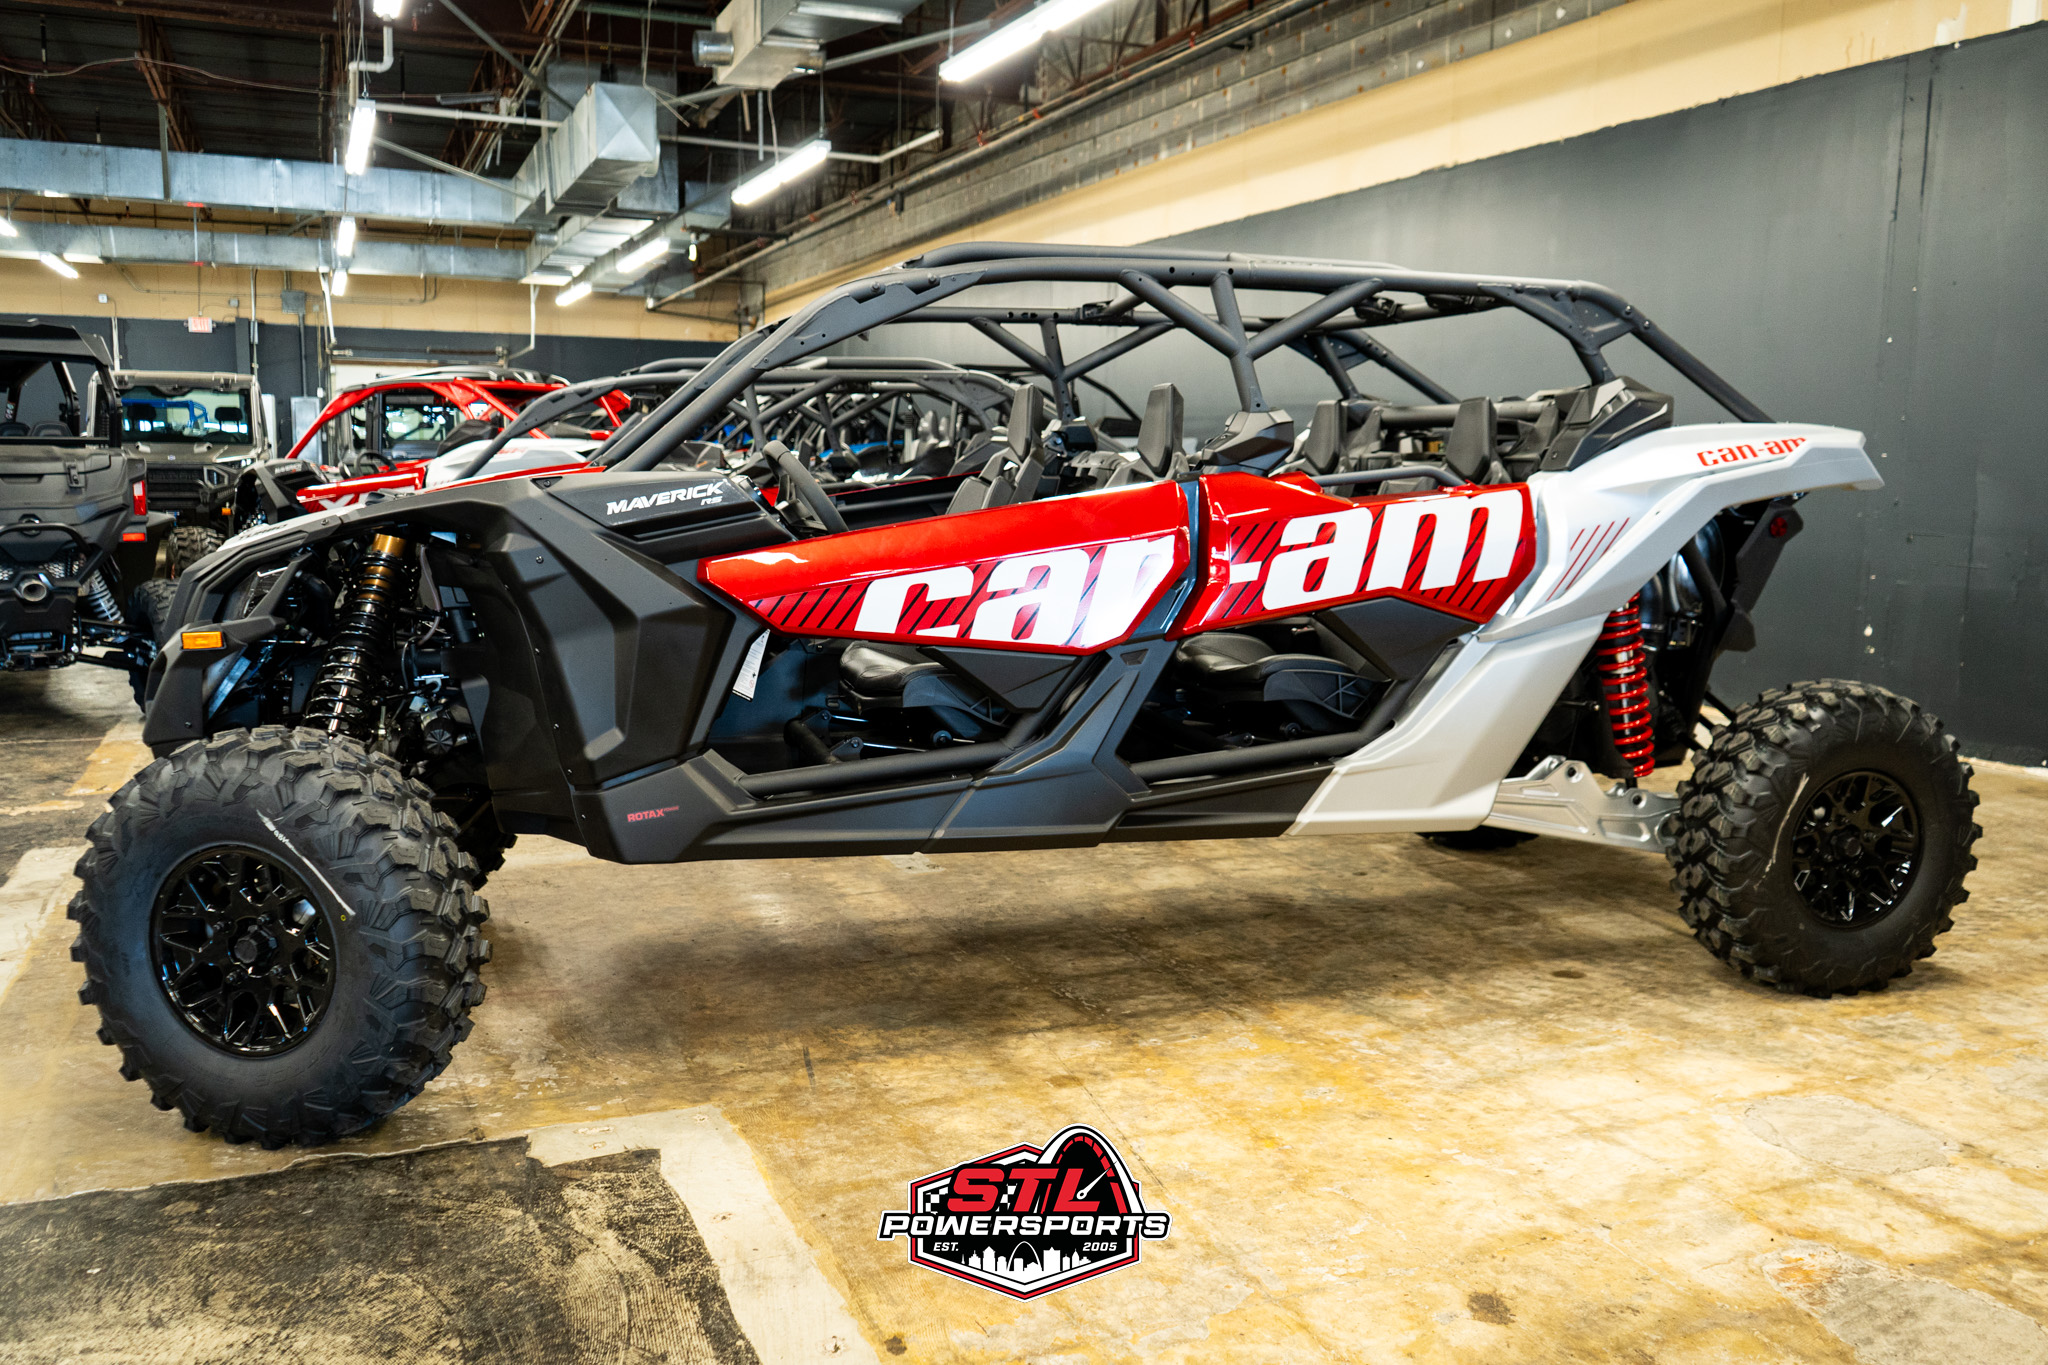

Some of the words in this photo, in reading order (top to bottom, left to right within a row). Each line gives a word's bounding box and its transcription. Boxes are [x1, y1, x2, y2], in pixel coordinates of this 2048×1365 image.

[1697, 437, 1807, 467] can-am
[606, 481, 724, 516] MAVERICK
[700, 496, 723, 506] RS
[627, 808, 665, 823] ROTAX
